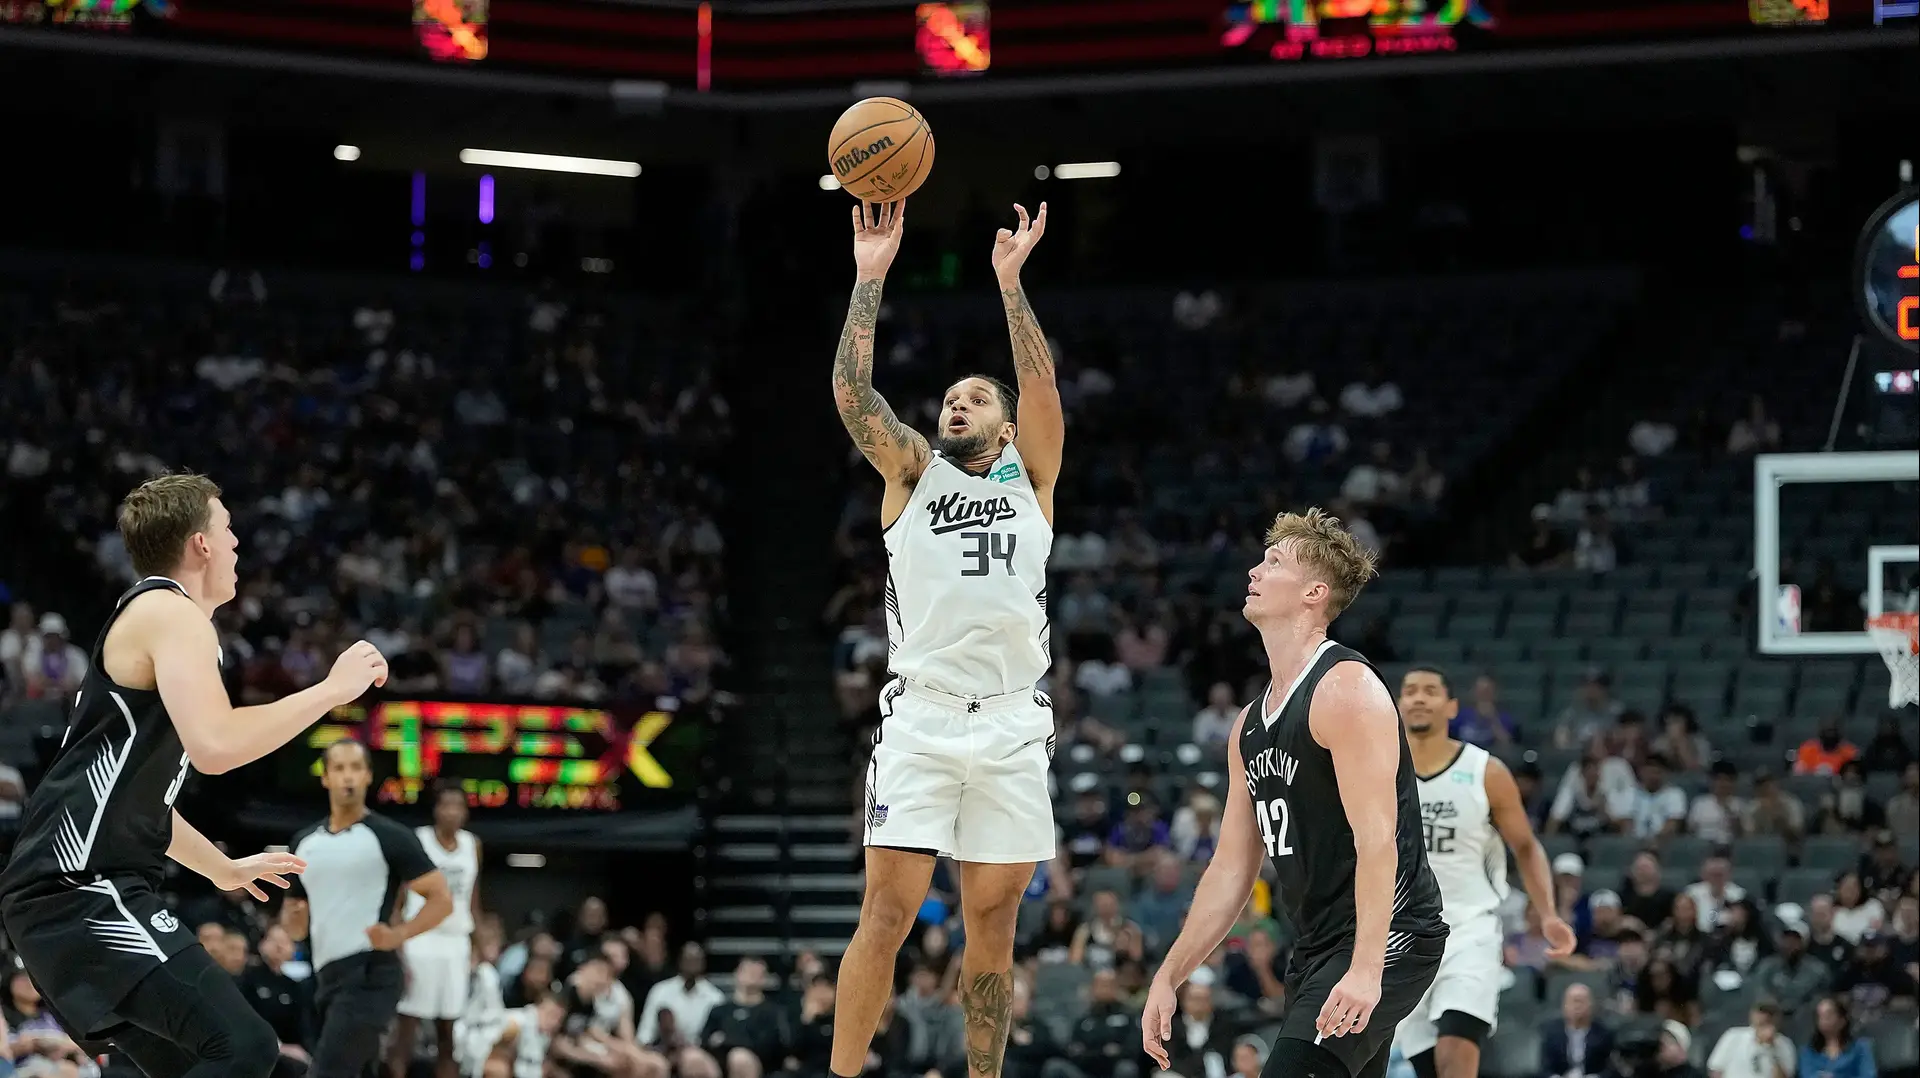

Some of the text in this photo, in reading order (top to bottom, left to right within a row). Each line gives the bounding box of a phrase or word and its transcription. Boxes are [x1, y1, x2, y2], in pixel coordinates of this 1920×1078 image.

[834, 135, 896, 177] Wilson
[925, 491, 1017, 535] Kings
[960, 532, 1017, 577] 34
[1256, 797, 1294, 858] 42
